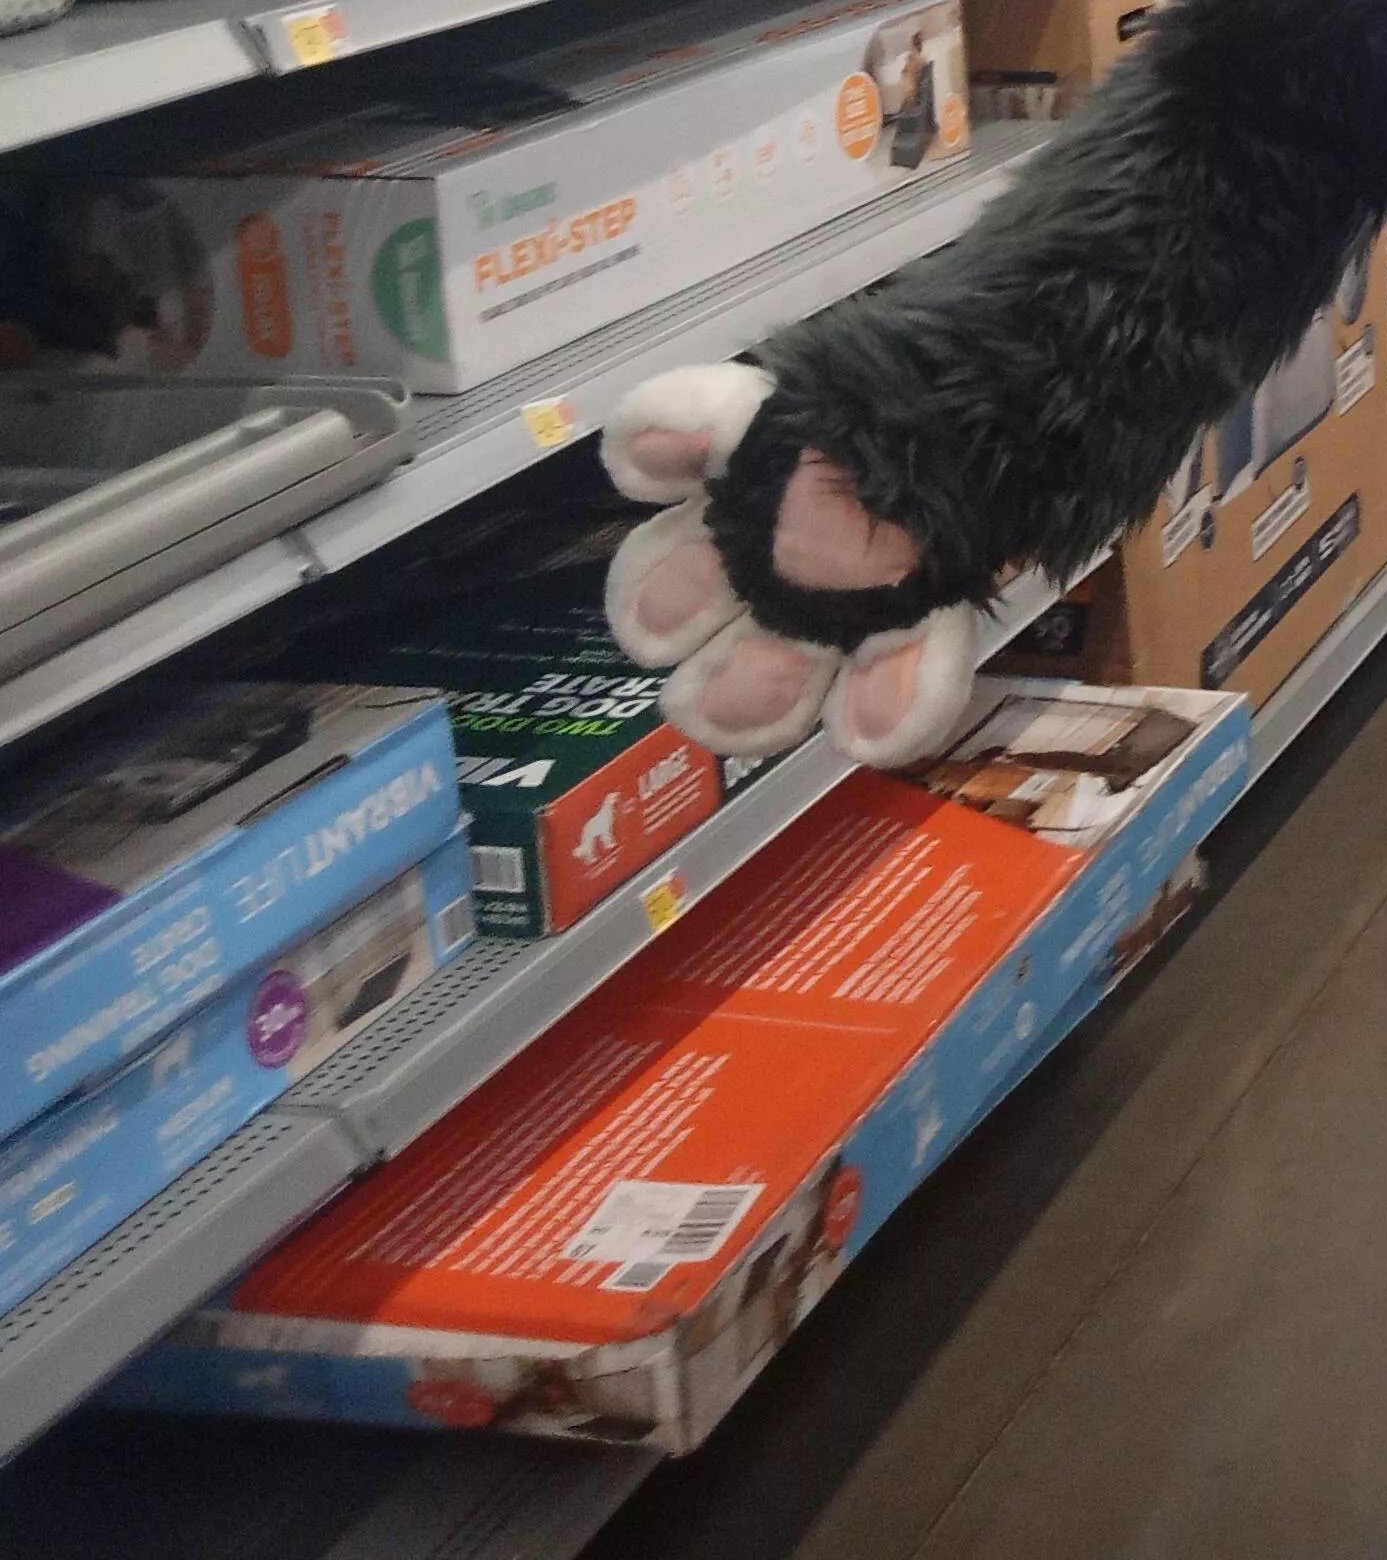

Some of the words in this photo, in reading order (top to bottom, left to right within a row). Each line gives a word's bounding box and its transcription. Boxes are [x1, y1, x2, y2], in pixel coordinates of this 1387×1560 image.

[531, 696, 657, 719] DOG
[534, 718, 625, 737] TWO
[304, 760, 442, 874] VIBRANT
